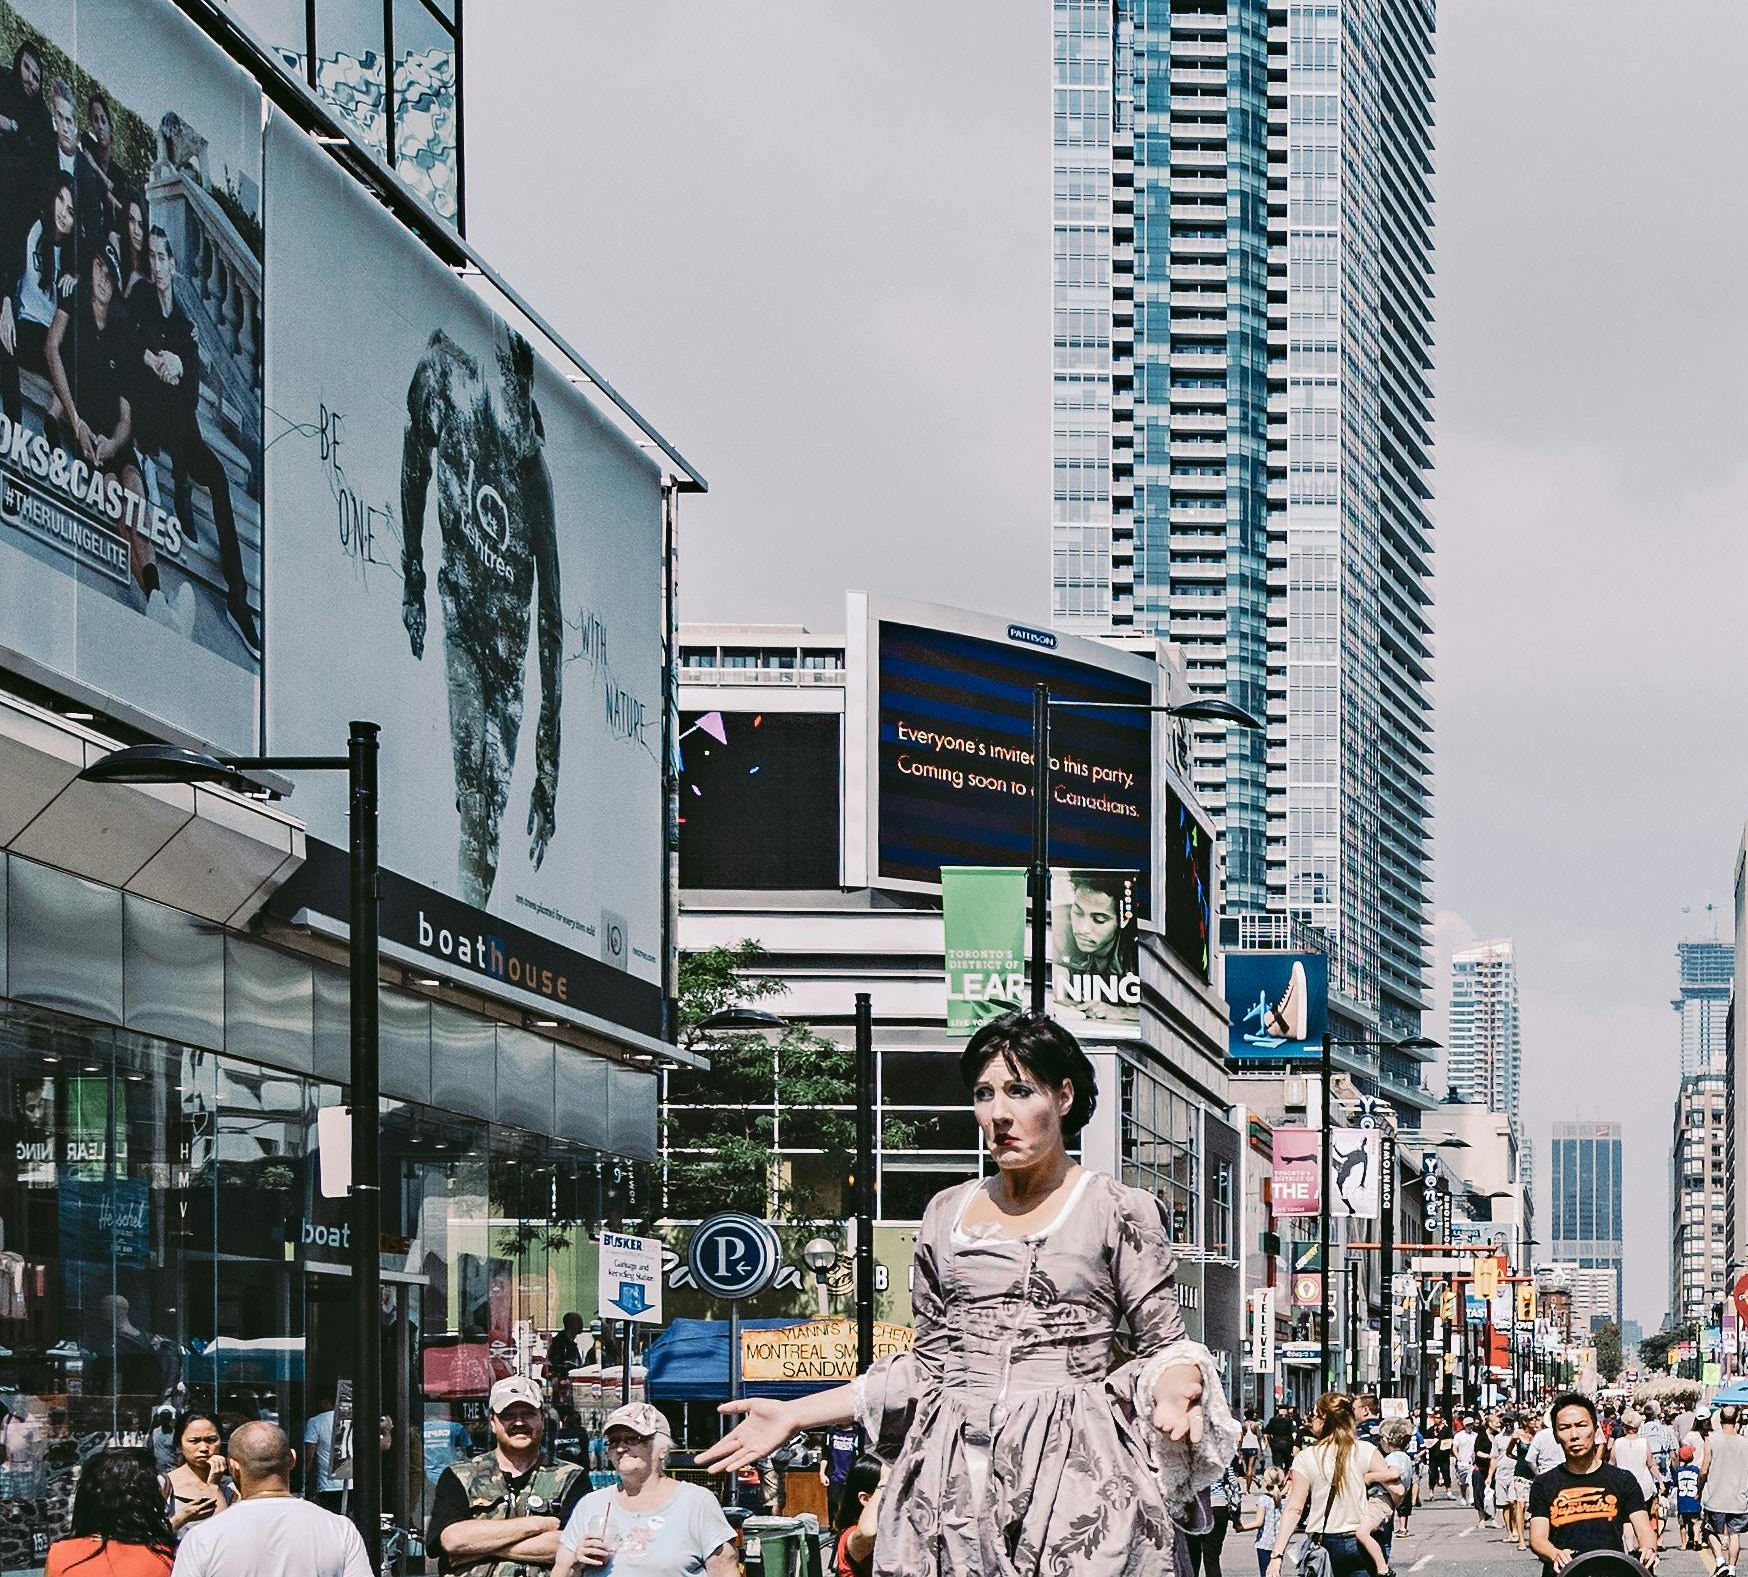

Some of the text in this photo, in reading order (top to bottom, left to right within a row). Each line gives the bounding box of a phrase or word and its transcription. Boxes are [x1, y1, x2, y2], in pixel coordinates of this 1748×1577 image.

[4, 486, 128, 570] #THERULINGELITE
[1010, 628, 1054, 646] PATTISON
[898, 722, 986, 756] Everyone's
[1064, 754, 1088, 777] this
[898, 755, 963, 788] Coming
[968, 773, 1007, 791] soon
[1012, 780, 1027, 796] to
[1054, 784, 1140, 817] Canadians.
[418, 911, 567, 1000] boathouse
[950, 950, 1013, 959] TORONTO'S
[950, 960, 1019, 970] DISTRICT OF
[1383, 1142, 1391, 1209] DOWNTOWN
[1271, 1183, 1309, 1200] THE
[603, 1234, 643, 1251] BUSKER
[746, 1343, 826, 1360] MONTREAL
[1678, 1480, 1698, 1497] 55
